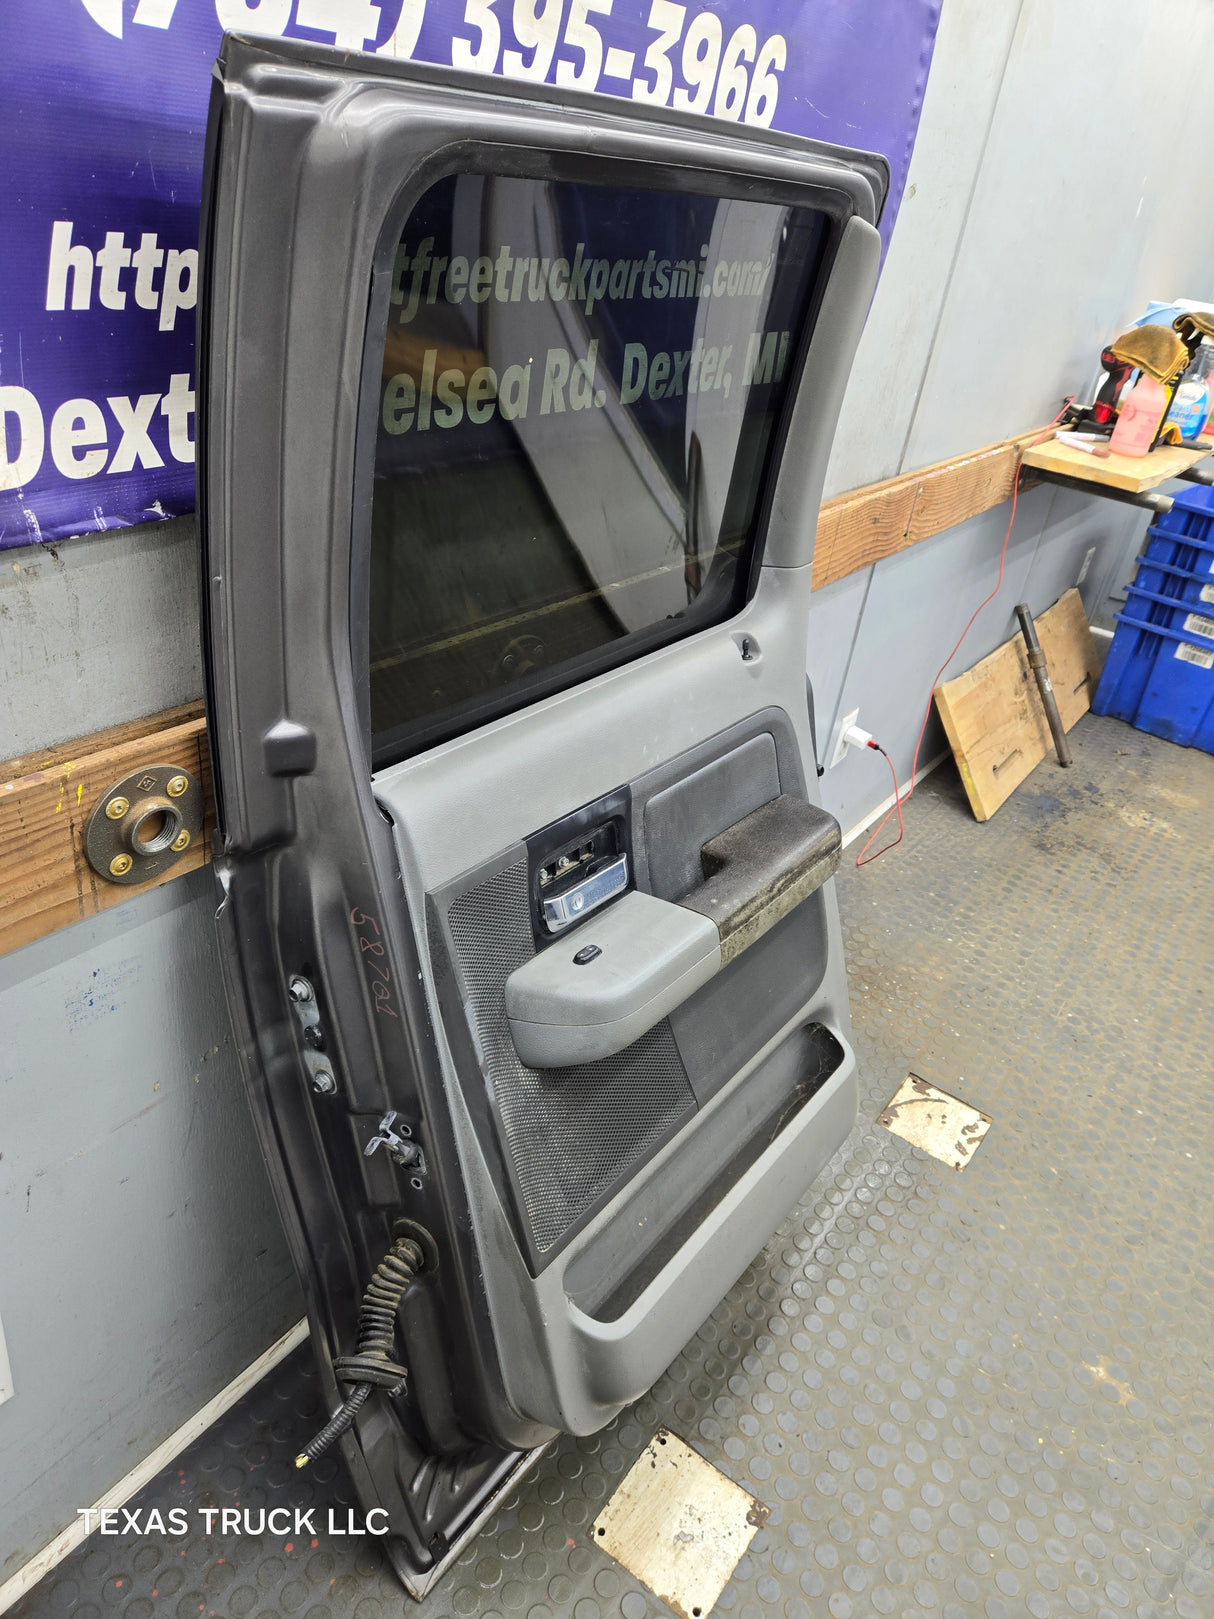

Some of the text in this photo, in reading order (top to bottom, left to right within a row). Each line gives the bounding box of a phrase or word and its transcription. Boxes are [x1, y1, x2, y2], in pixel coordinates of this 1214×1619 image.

[540, 338, 607, 416] Rd.
[619, 337, 733, 406] Dexter,
[741, 330, 790, 387] MI
